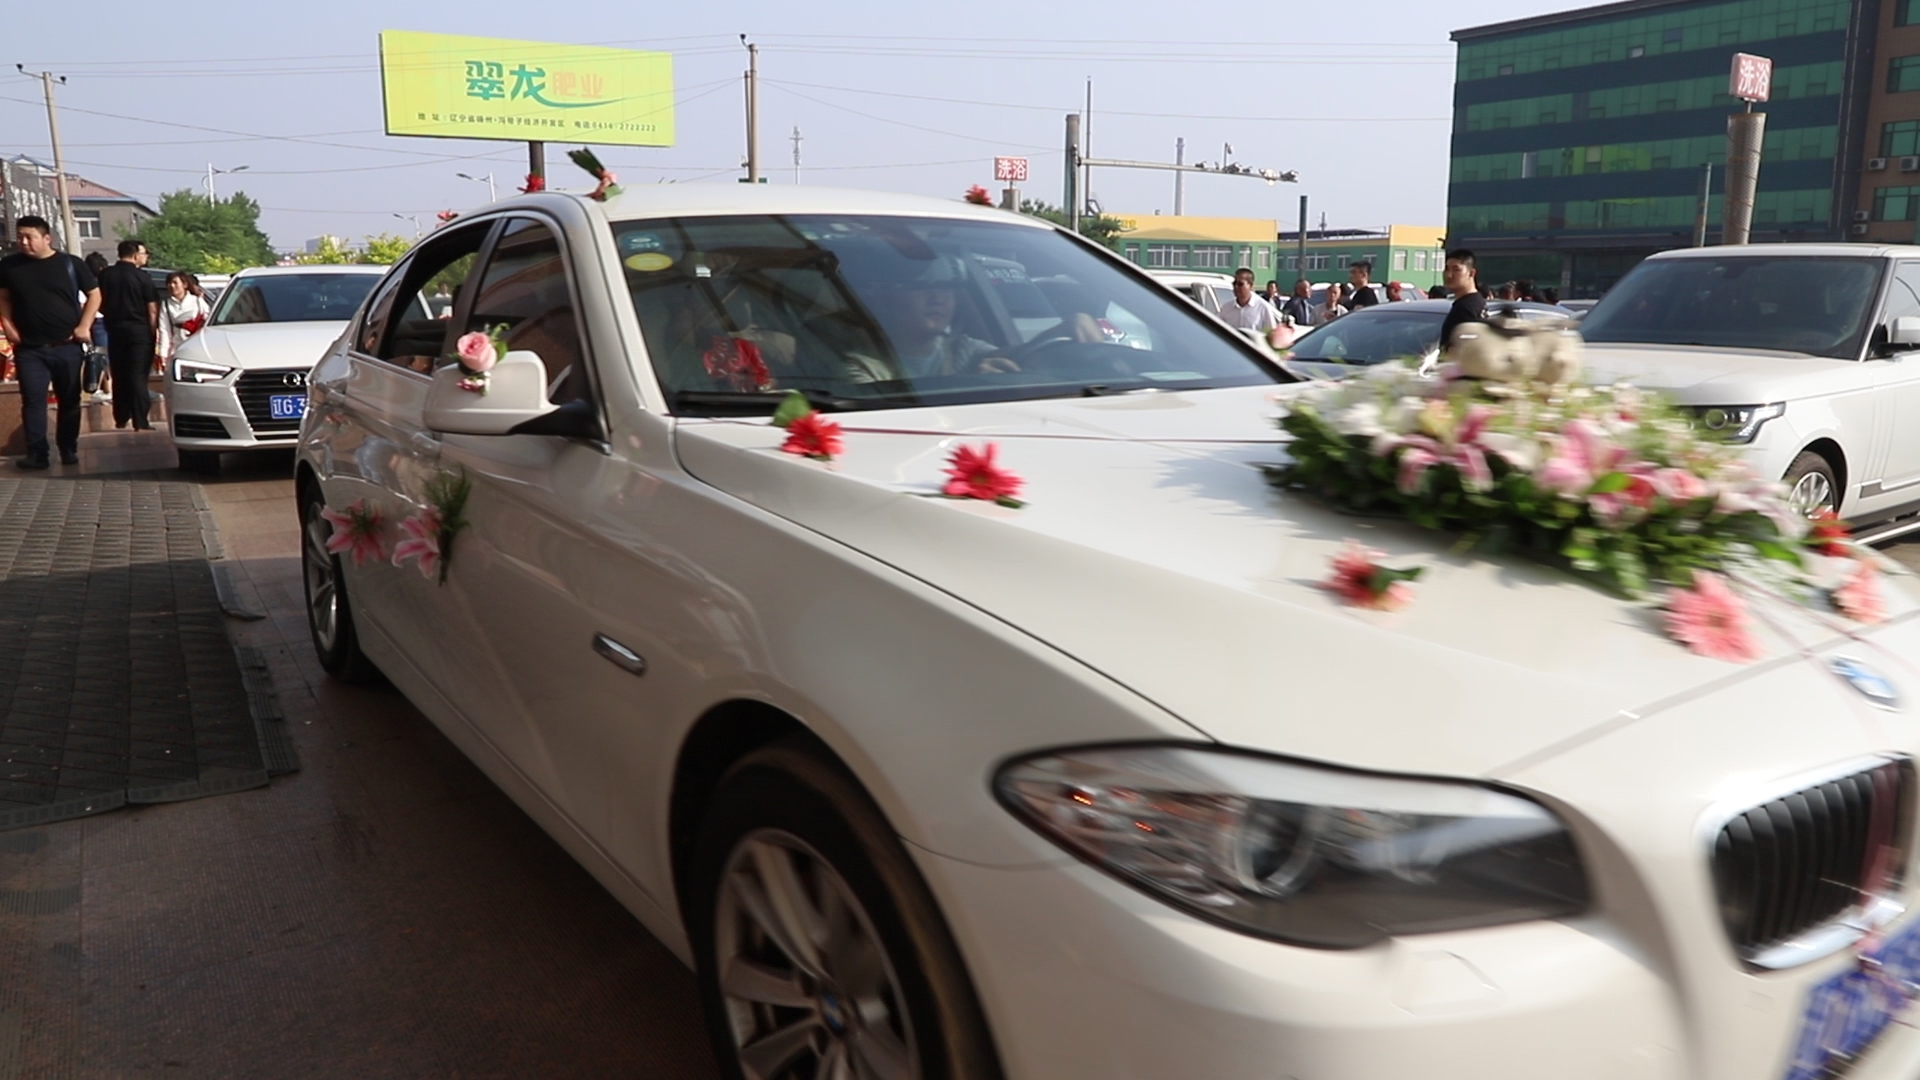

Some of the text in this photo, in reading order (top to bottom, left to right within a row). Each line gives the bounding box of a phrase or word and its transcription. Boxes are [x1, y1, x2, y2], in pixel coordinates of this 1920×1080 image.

[465, 60, 604, 107] 翠龙肥业
[1739, 59, 1770, 97] 洗浴
[998, 159, 1026, 179] 洗浴
